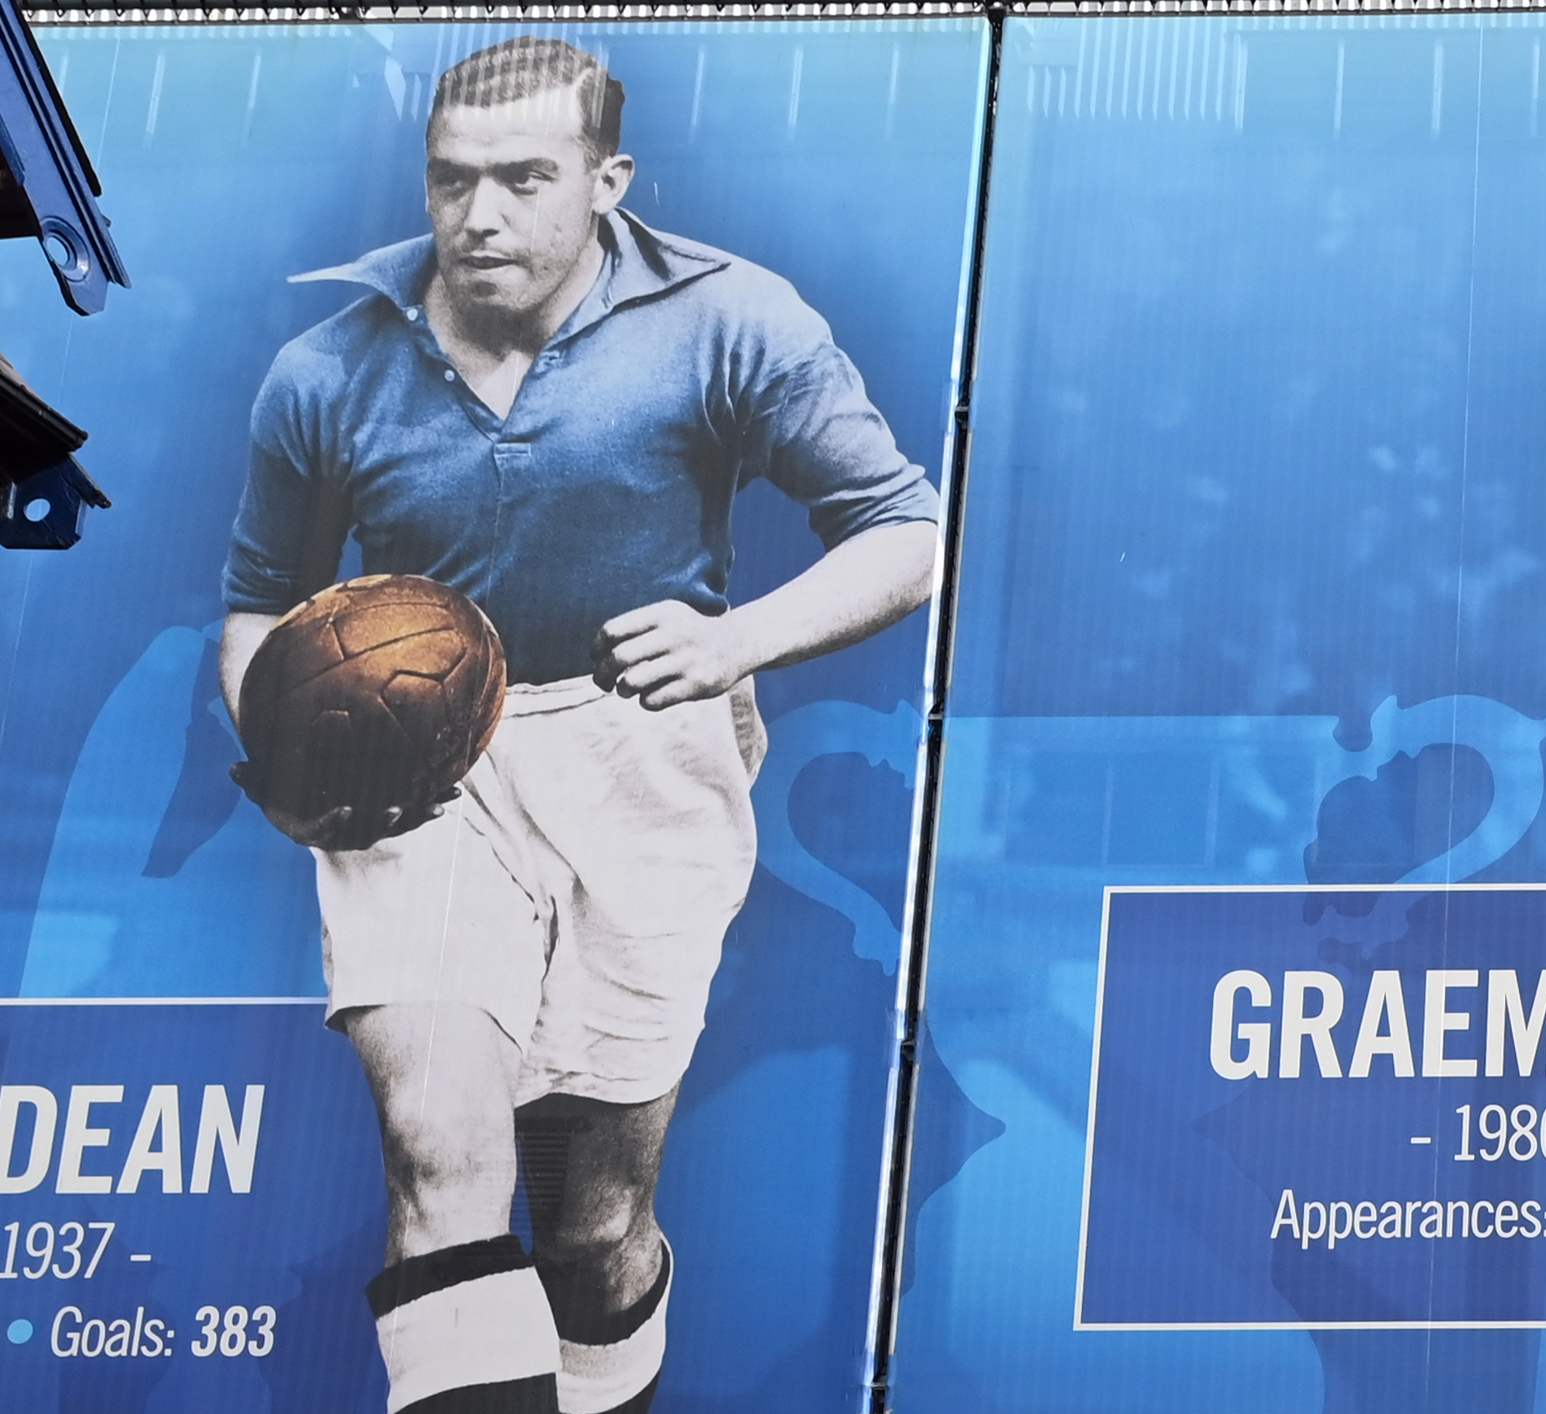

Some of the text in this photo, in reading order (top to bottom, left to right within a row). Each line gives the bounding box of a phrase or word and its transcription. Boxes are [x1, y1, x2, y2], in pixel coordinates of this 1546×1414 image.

[0, 1084, 265, 1194] DEAN
[0, 1222, 115, 1279] 1937
[50, 1305, 275, 1357] Goals: 383
